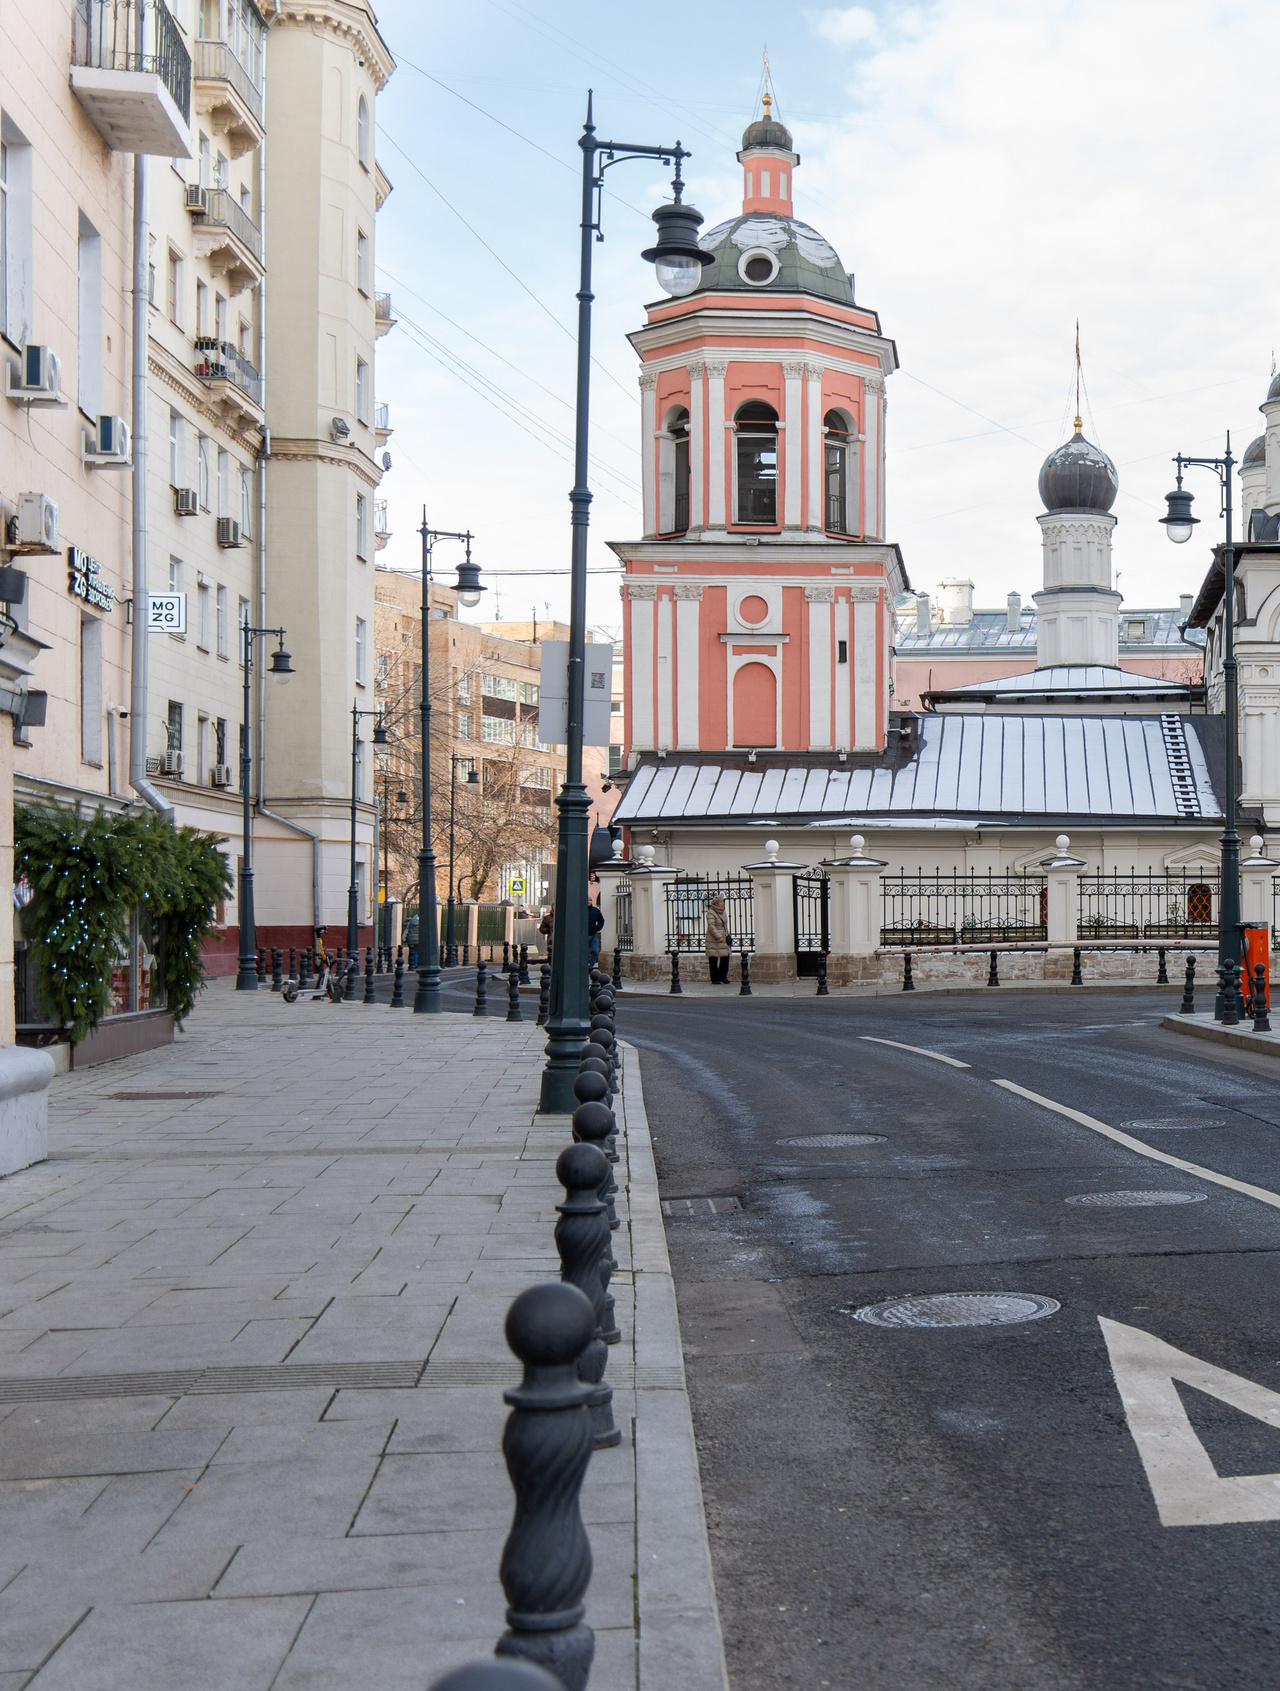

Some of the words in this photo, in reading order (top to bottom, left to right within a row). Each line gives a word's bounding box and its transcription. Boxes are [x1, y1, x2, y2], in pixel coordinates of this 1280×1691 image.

[73, 546, 87, 573] MO
[73, 571, 87, 598] ZG
[152, 601, 175, 611] MO
[152, 613, 174, 622] ZG
